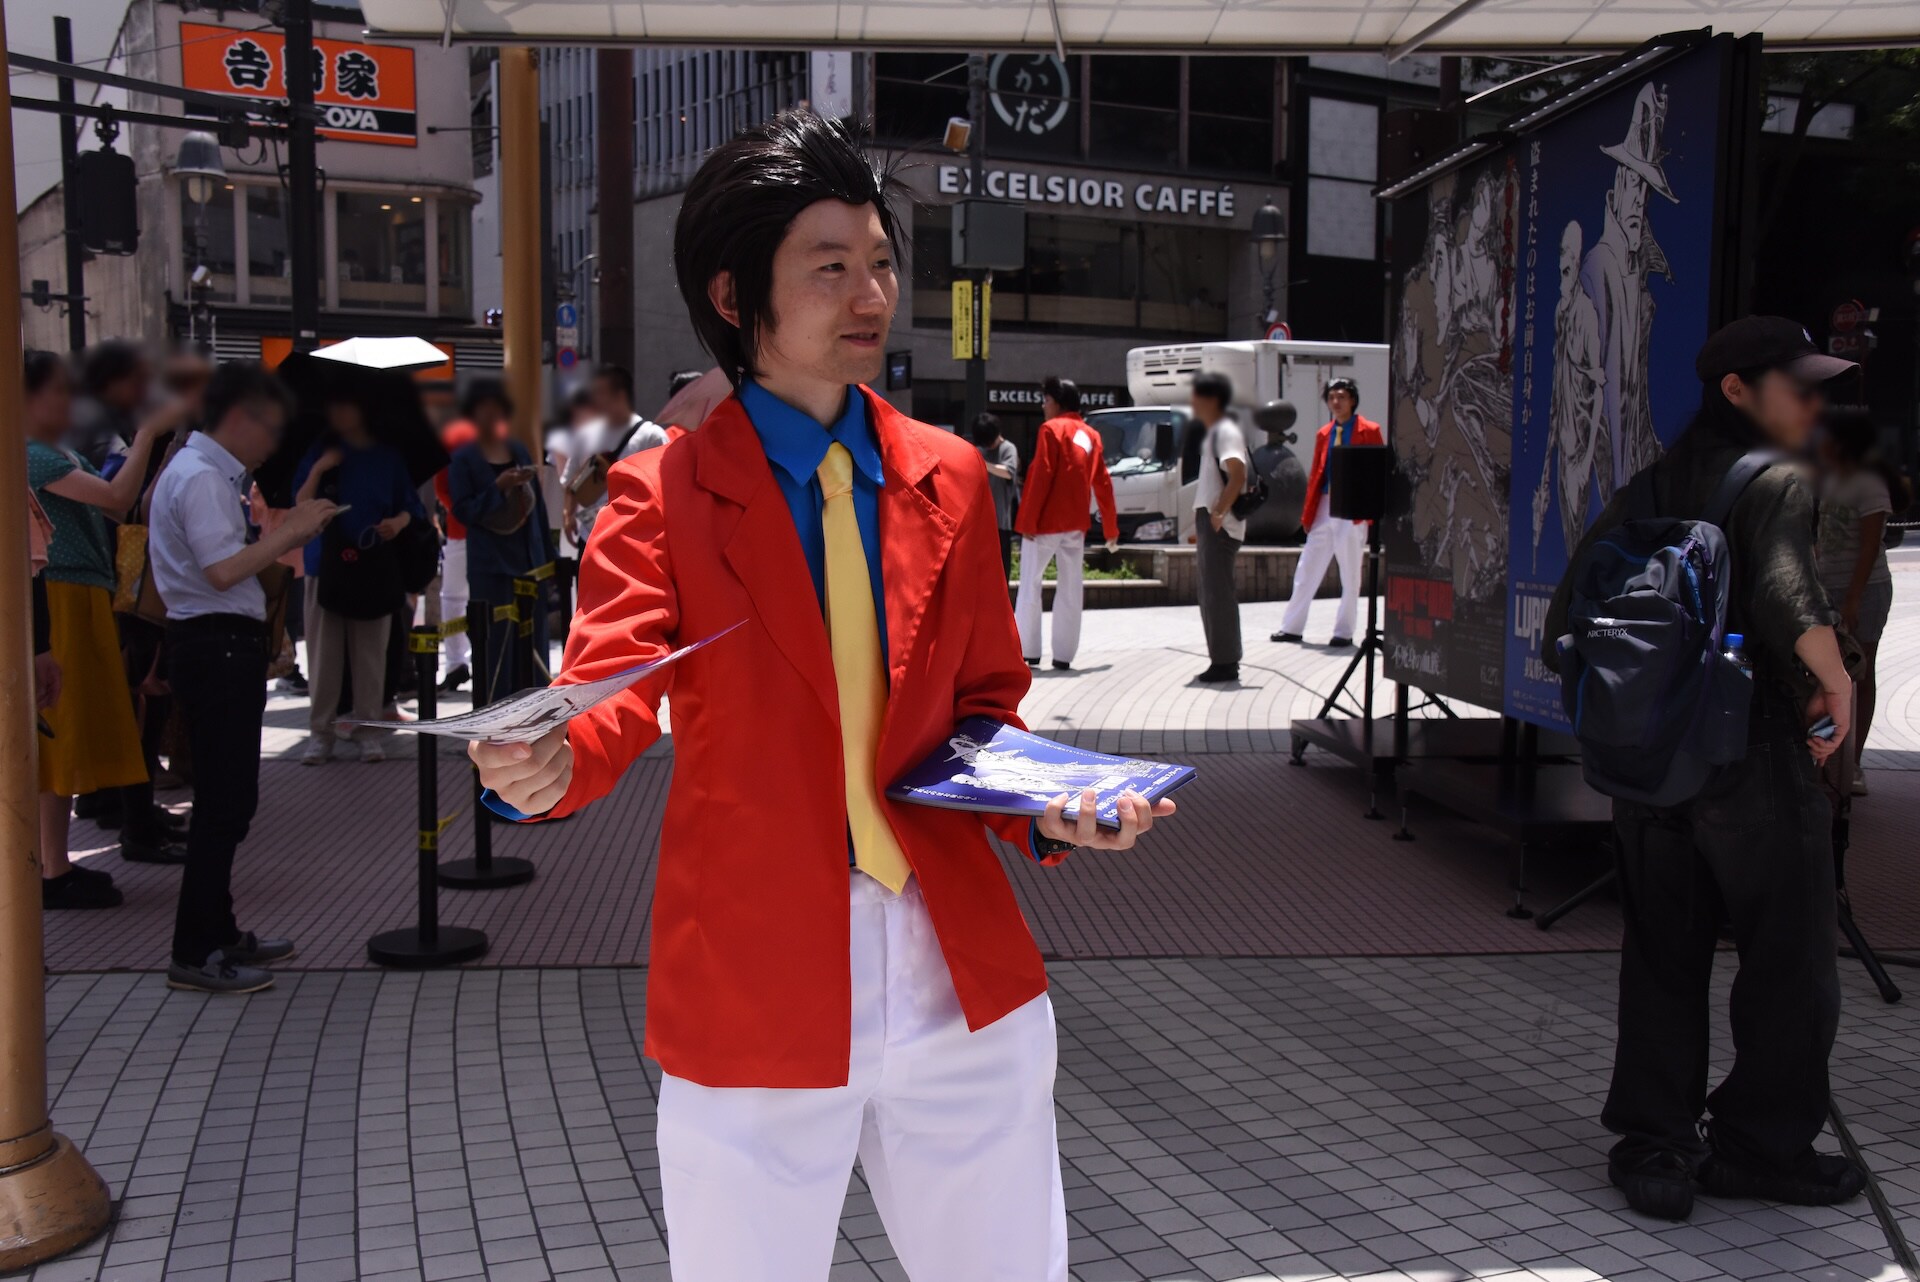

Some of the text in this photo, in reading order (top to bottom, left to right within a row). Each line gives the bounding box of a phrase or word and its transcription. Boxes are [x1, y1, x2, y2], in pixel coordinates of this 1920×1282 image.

[939, 166, 1235, 218] EXCELSIOR CAFFÉ
[1079, 392, 1115, 406] AFFÉ
[1514, 594, 1551, 651] LUPI
